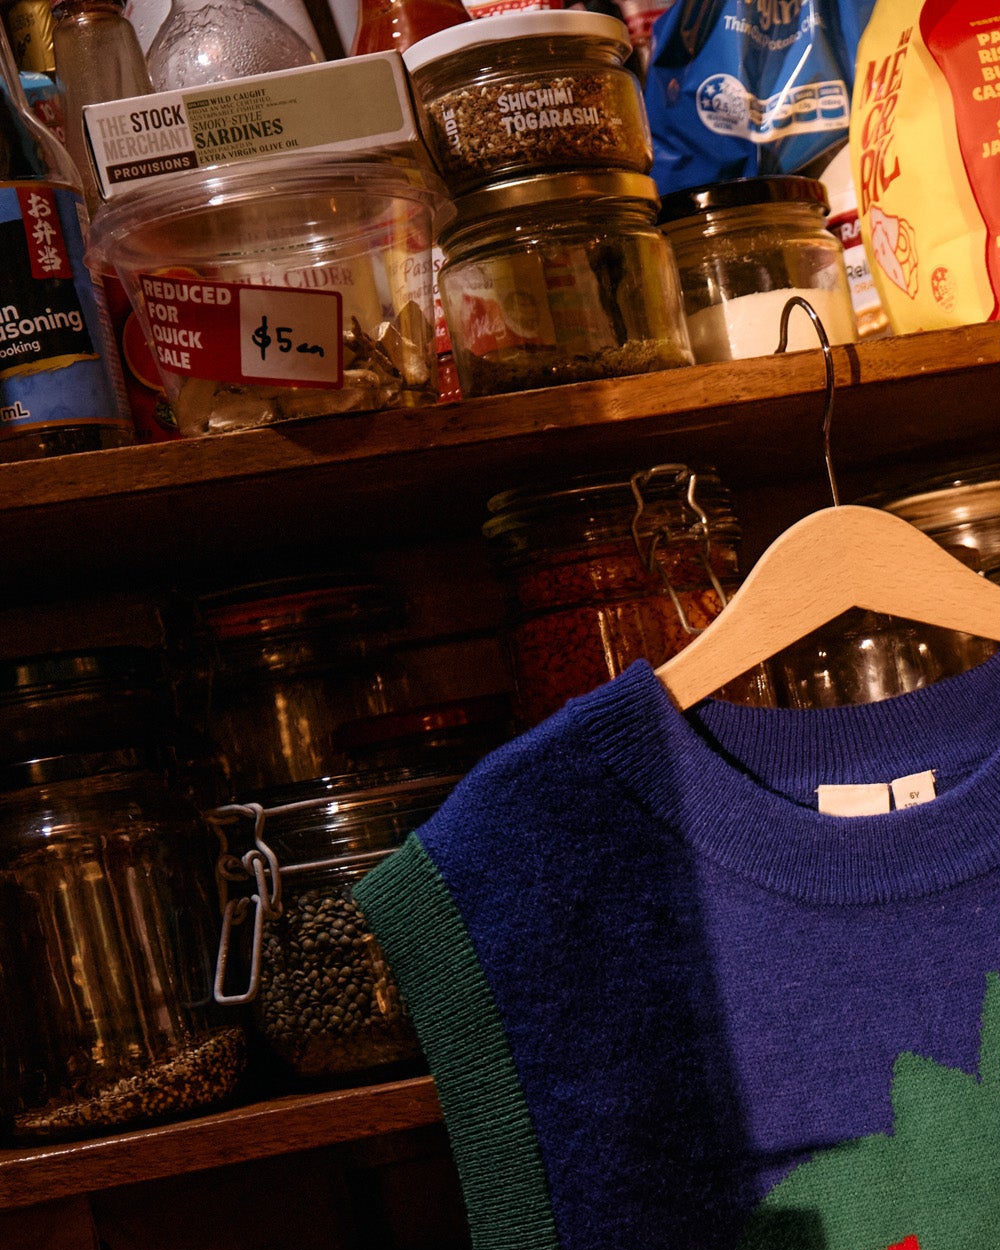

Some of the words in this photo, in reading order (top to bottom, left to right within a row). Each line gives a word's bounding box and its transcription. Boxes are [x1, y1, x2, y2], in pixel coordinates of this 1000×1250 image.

[210, 96, 231, 105] WILD
[233, 88, 267, 101] CAUGHT
[498, 87, 574, 114] SHICHIMI
[96, 114, 130, 139] THE
[130, 104, 186, 133] STOCK
[194, 118, 284, 149] SARDINES
[501, 107, 600, 137] TŌGARASHI
[102, 127, 191, 162] MERCHANT
[200, 153, 226, 164] EXTRA
[228, 148, 257, 158] VIRGIN
[259, 142, 283, 153] OLIVE
[285, 139, 299, 148] OIL
[114, 156, 191, 180] PROVISIONS
[27, 192, 62, 273] お弁当
[142, 279, 232, 306] REDUCED
[149, 301, 179, 324] FOR
[152, 324, 203, 350] QUICK
[157, 345, 192, 370] SALE
[909, 791, 920, 800] 6Y
